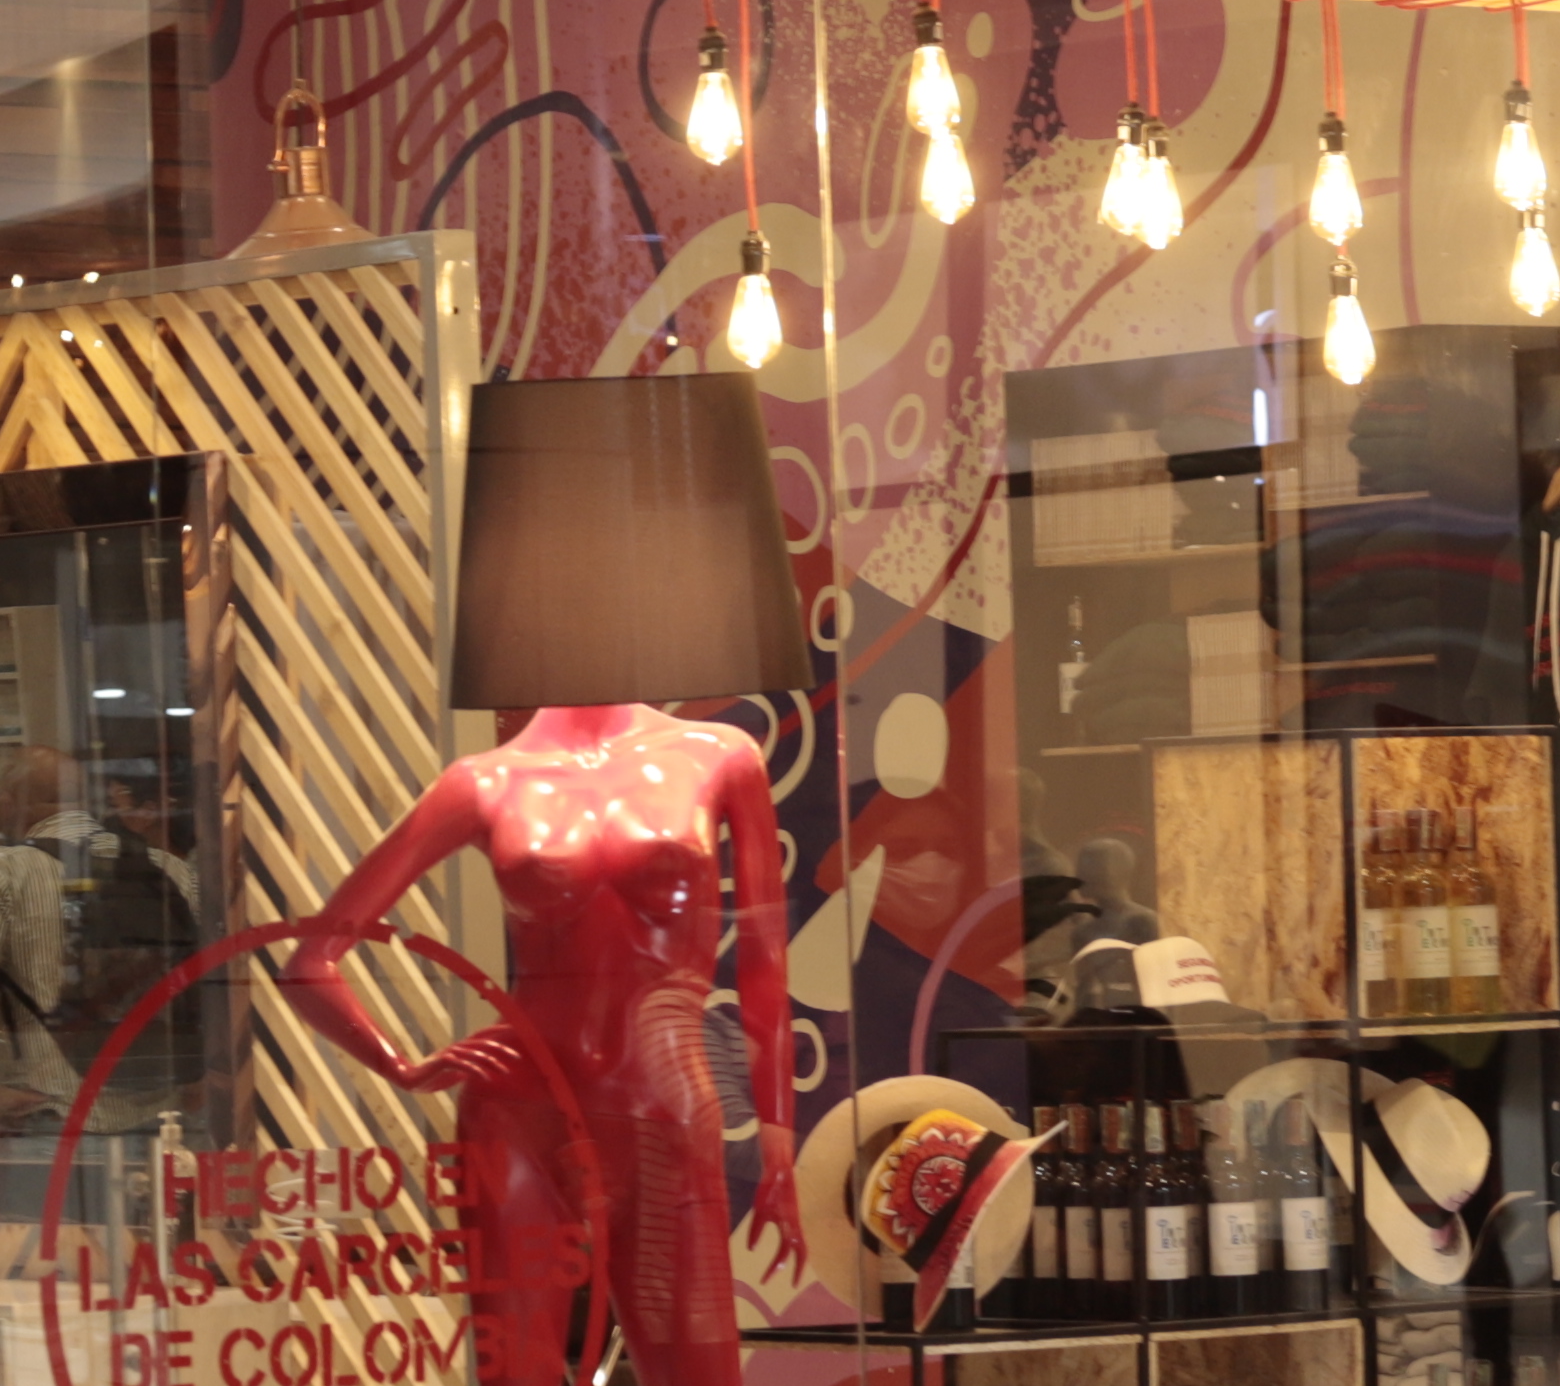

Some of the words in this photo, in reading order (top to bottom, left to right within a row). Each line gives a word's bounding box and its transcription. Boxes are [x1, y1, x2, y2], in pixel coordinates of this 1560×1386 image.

[164, 1146, 404, 1219] HECHO
[425, 1139, 510, 1208] EN
[78, 1239, 216, 1313] LAS
